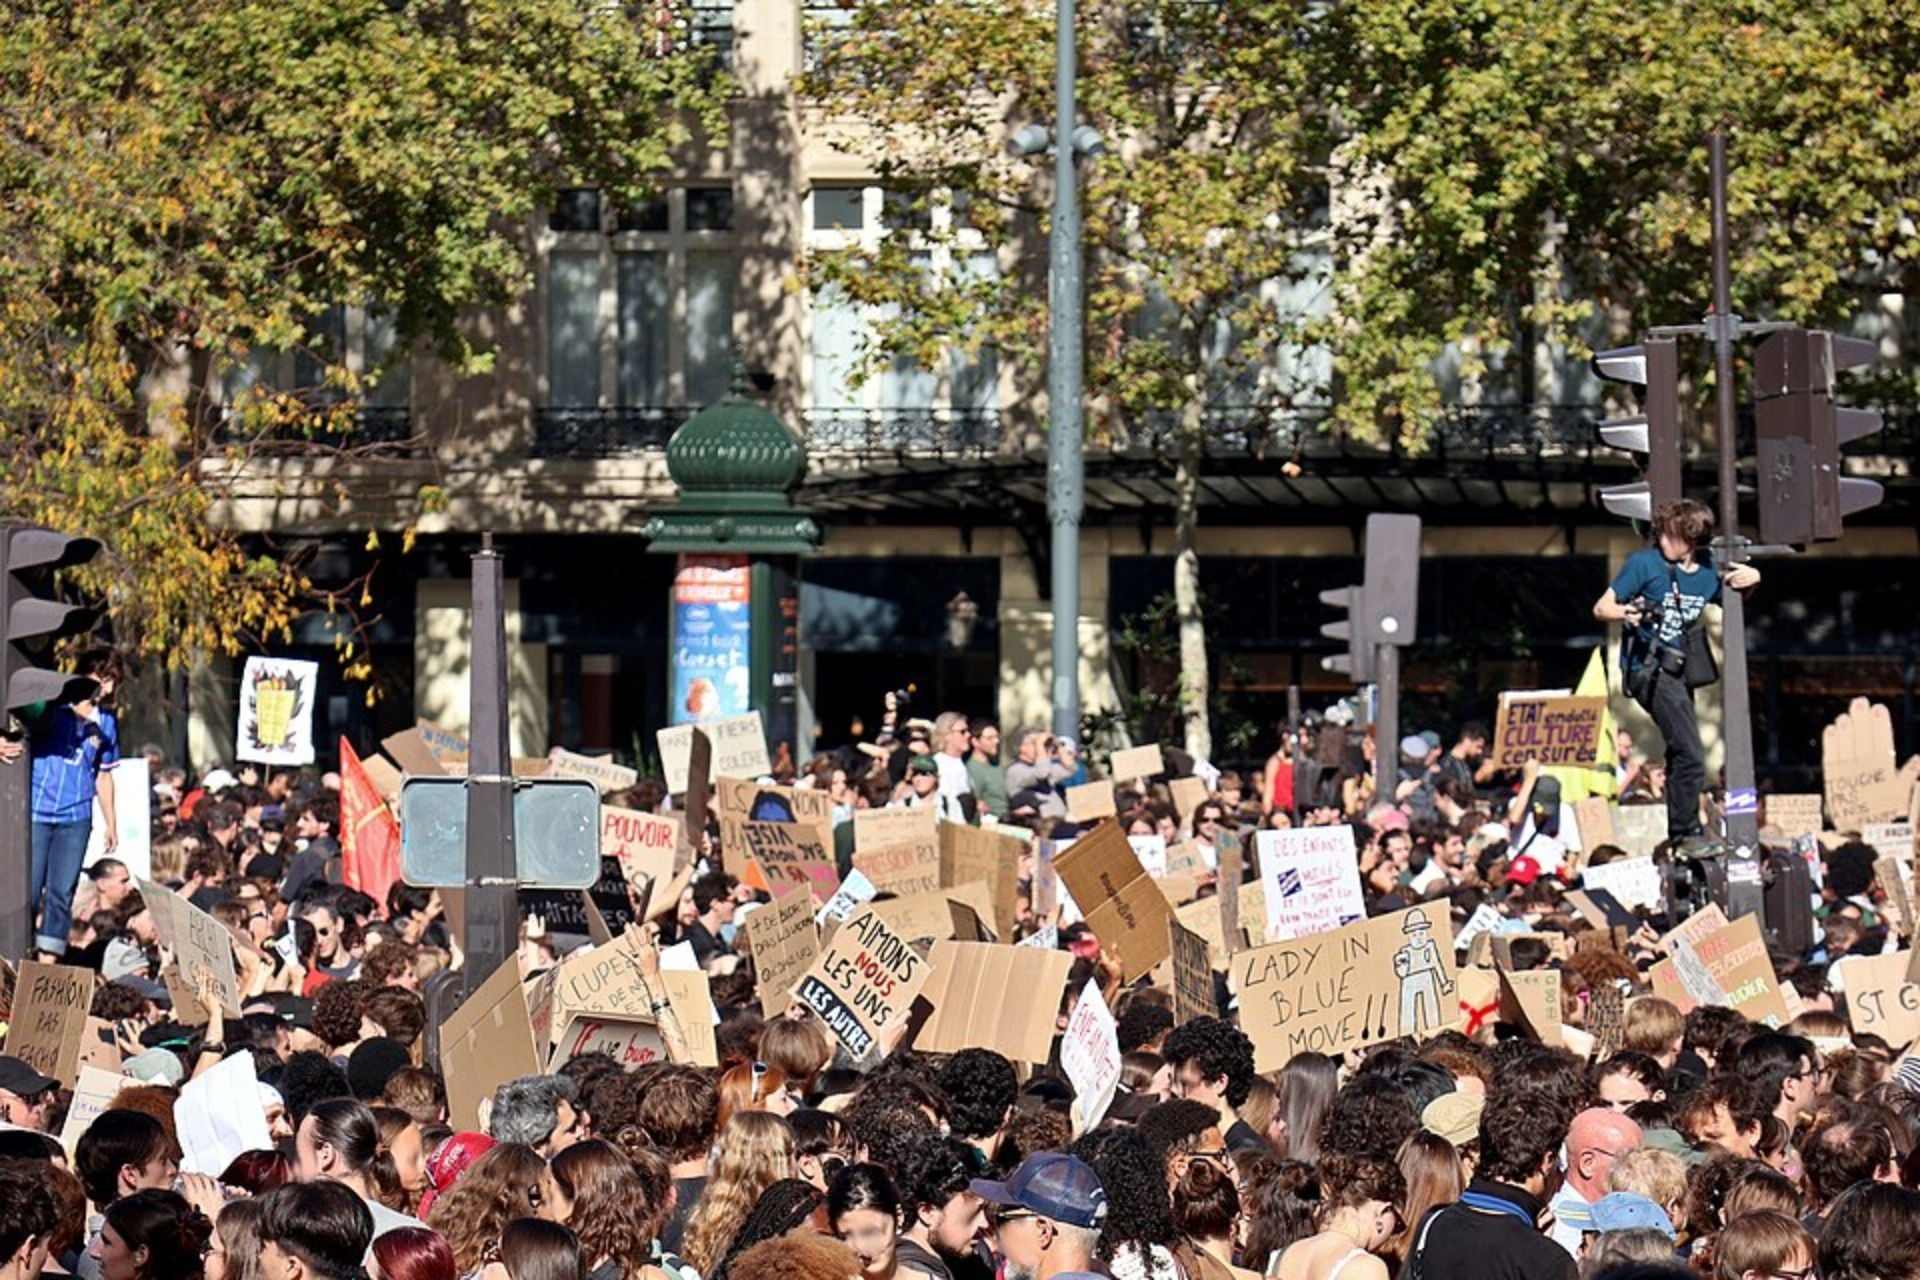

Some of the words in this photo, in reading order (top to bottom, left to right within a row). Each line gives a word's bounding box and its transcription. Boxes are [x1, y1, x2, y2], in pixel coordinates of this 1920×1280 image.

[1507, 702, 1547, 725] ETAT
[1504, 724, 1595, 747] CULTURE
[717, 779, 748, 814] ILS
[604, 813, 674, 849] POUVOIR
[1274, 837, 1298, 858] DES
[847, 912, 918, 983] AIMONS
[1244, 943, 1323, 987] LADY
[1342, 933, 1370, 962] IN
[823, 950, 857, 990] LES
[853, 984, 893, 1027] UNS
[855, 951, 896, 997] NOUS
[803, 981, 832, 1012] LES
[1270, 966, 1355, 1027] BLUE
[1856, 988, 1885, 1024] ST
